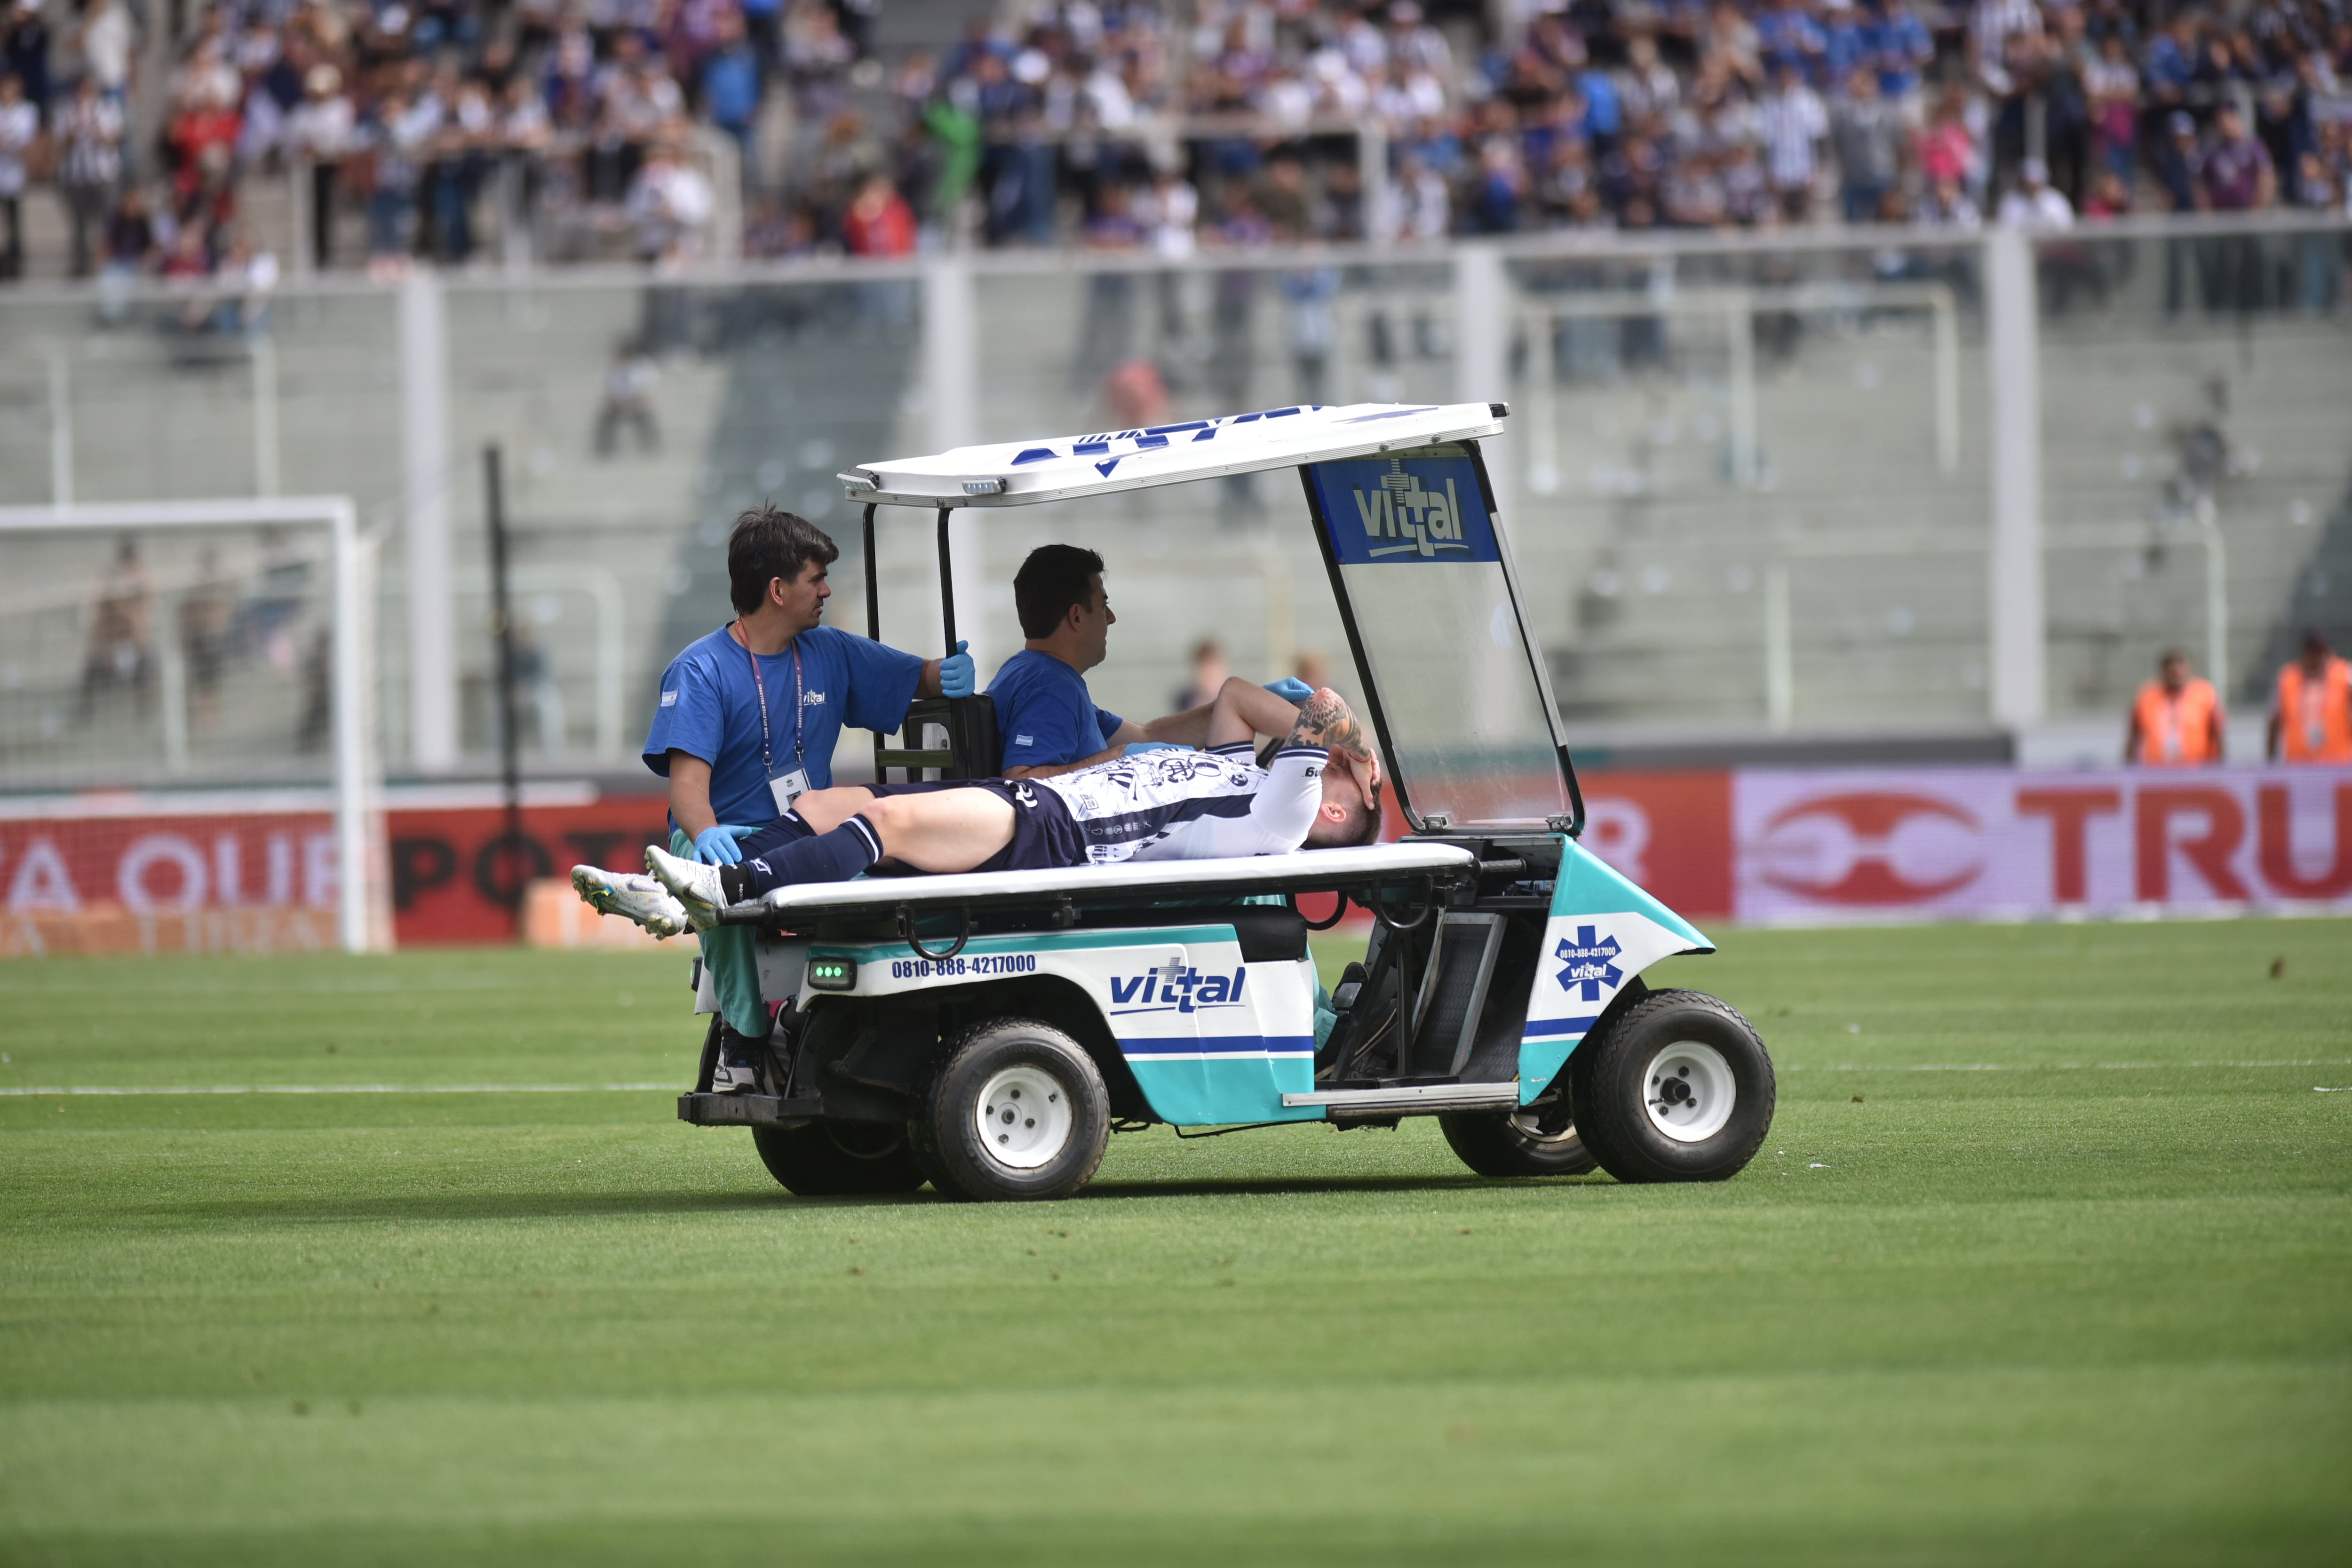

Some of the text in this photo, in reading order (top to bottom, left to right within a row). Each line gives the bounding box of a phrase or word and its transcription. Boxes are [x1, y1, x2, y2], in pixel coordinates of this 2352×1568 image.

[1560, 947, 1616, 959] 0810-888-4217000
[892, 955, 1036, 979] 0810-888-4217000
[1568, 963, 1611, 982] vittal
[1110, 957, 1247, 1015] vittal
